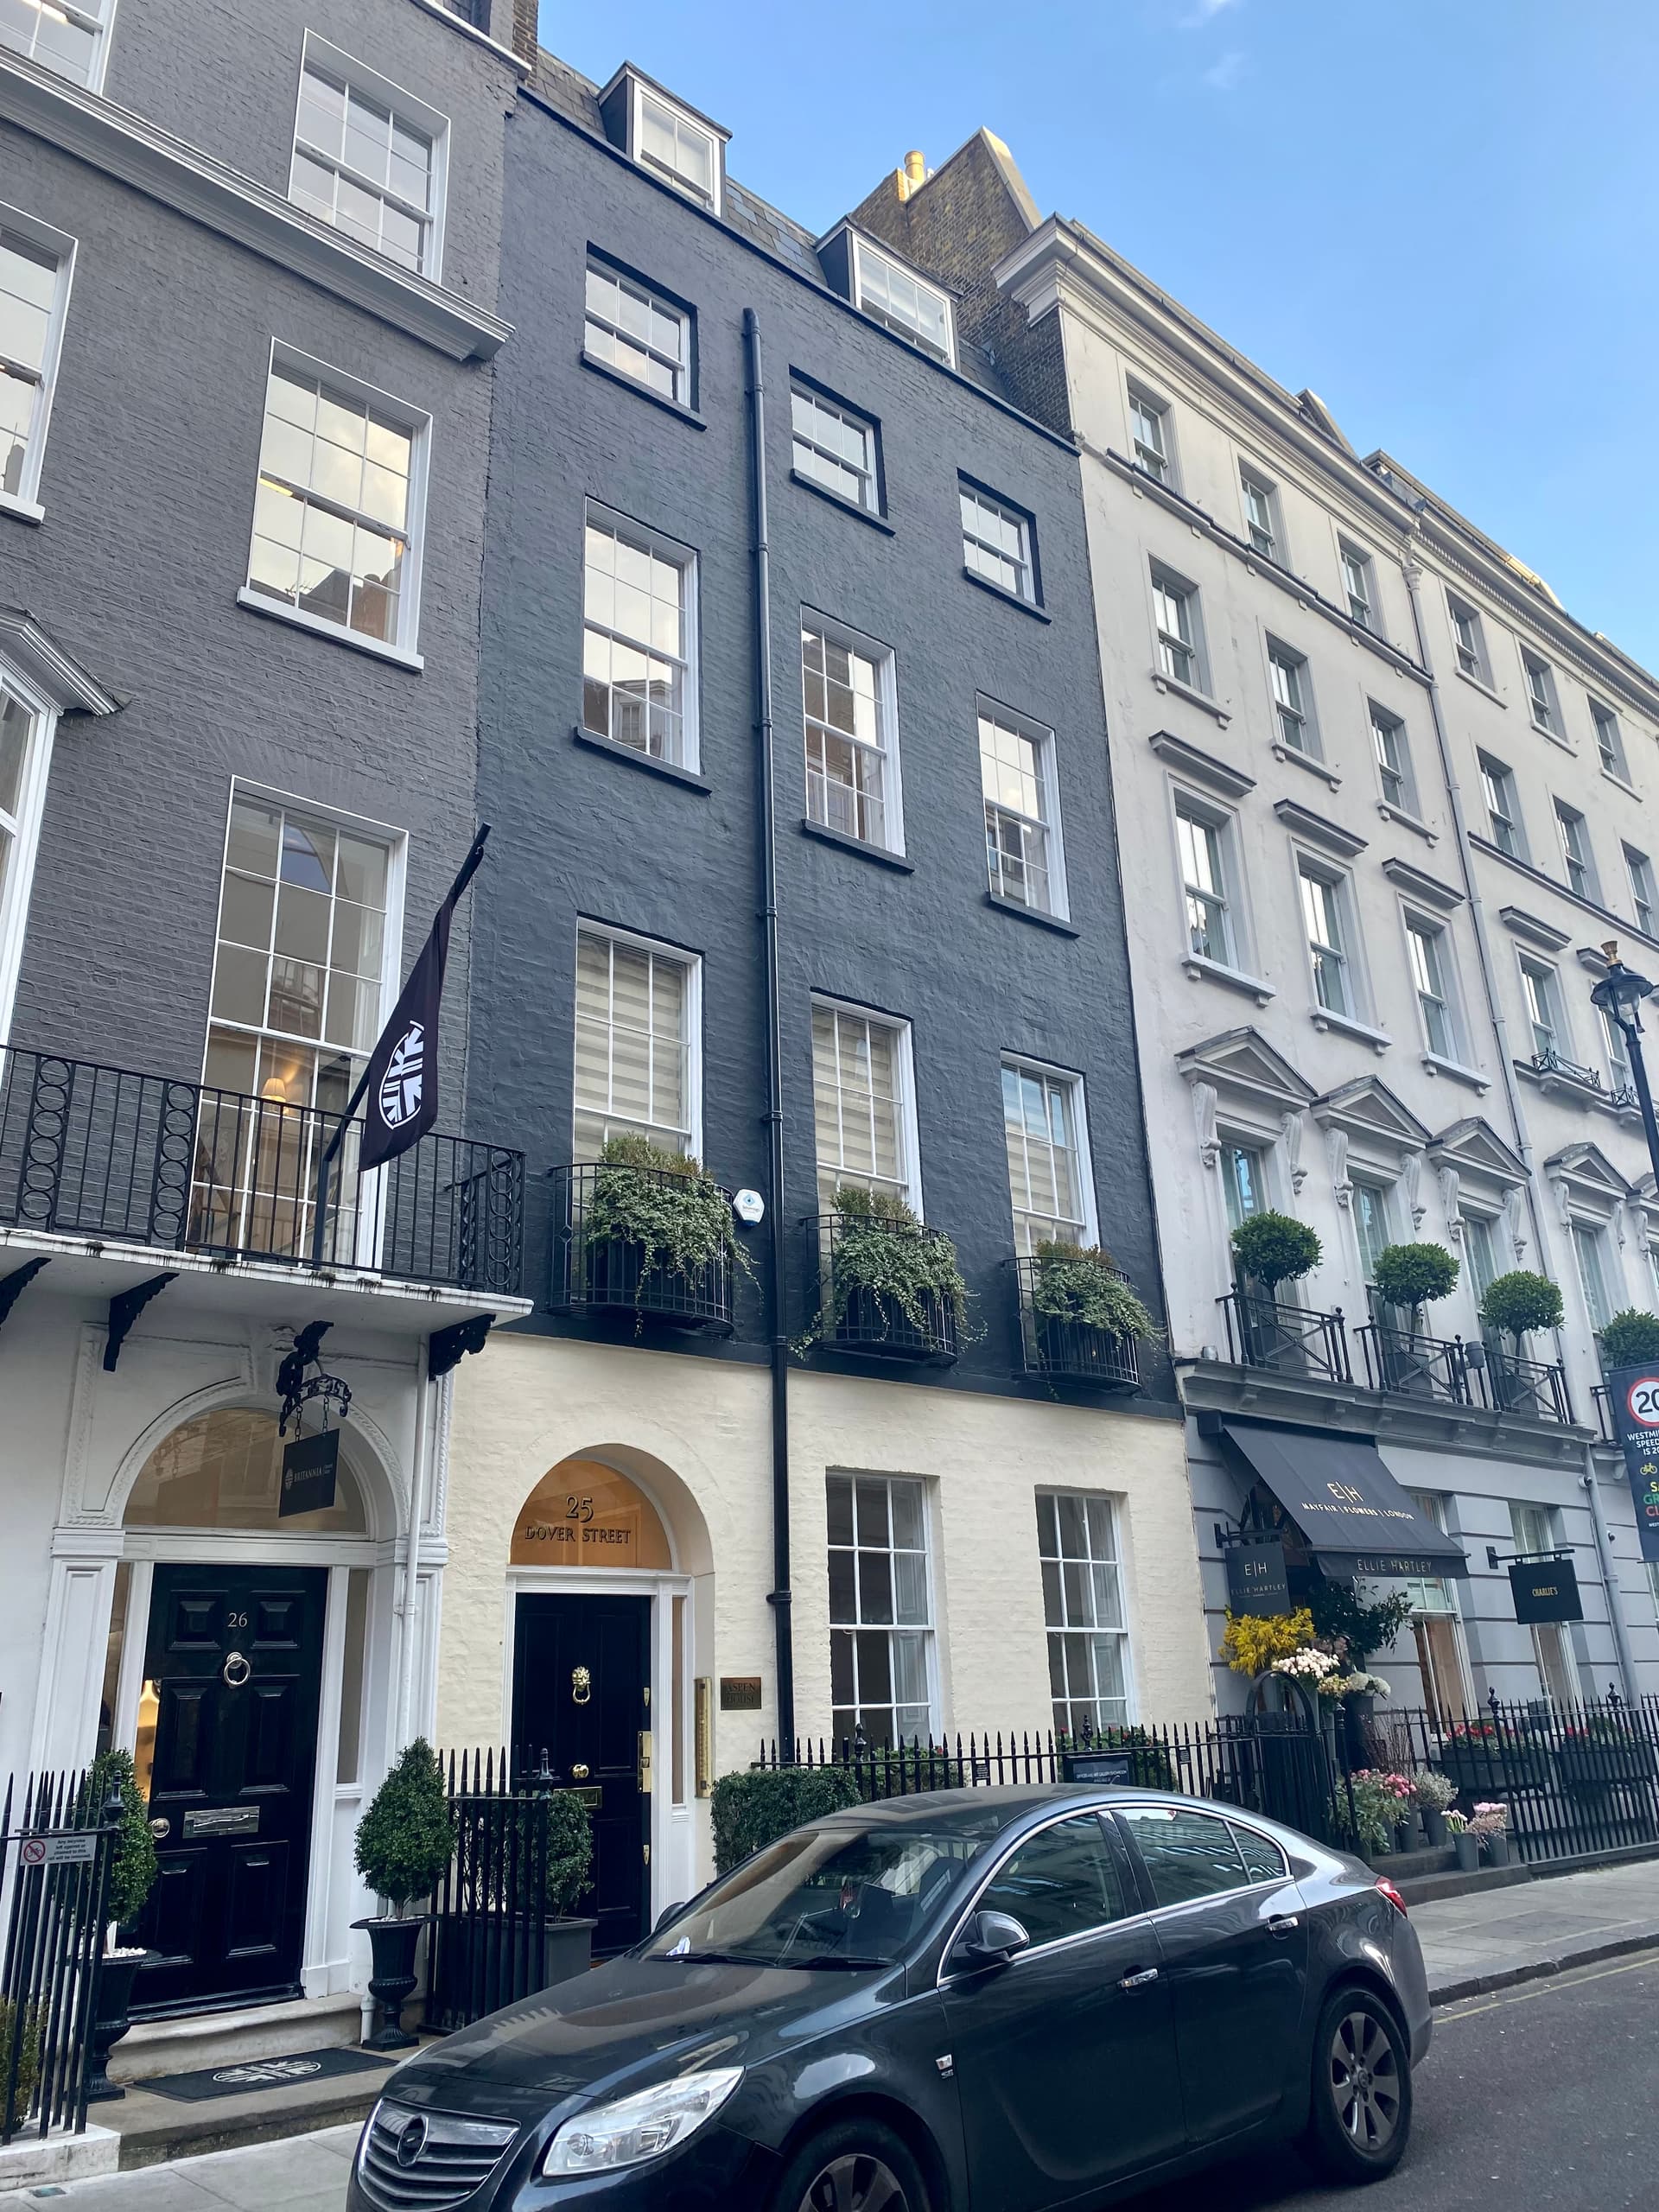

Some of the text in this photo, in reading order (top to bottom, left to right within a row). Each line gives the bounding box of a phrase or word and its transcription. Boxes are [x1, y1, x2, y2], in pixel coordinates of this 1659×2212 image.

[1643, 1447, 1651, 1456] IS
[566, 1495, 594, 1523] 25
[1301, 1503, 1338, 1513] MAYFAIR
[1344, 1506, 1378, 1516] FLOWERS
[1384, 1510, 1415, 1521] LONDON
[525, 1526, 632, 1544] DOVER STREET
[1357, 1559, 1433, 1573] ELLIE HARTLEY
[1254, 1584, 1286, 1593] HARTLEY
[227, 1611, 248, 1628] 26
[726, 1682, 755, 1692] ASPEN
